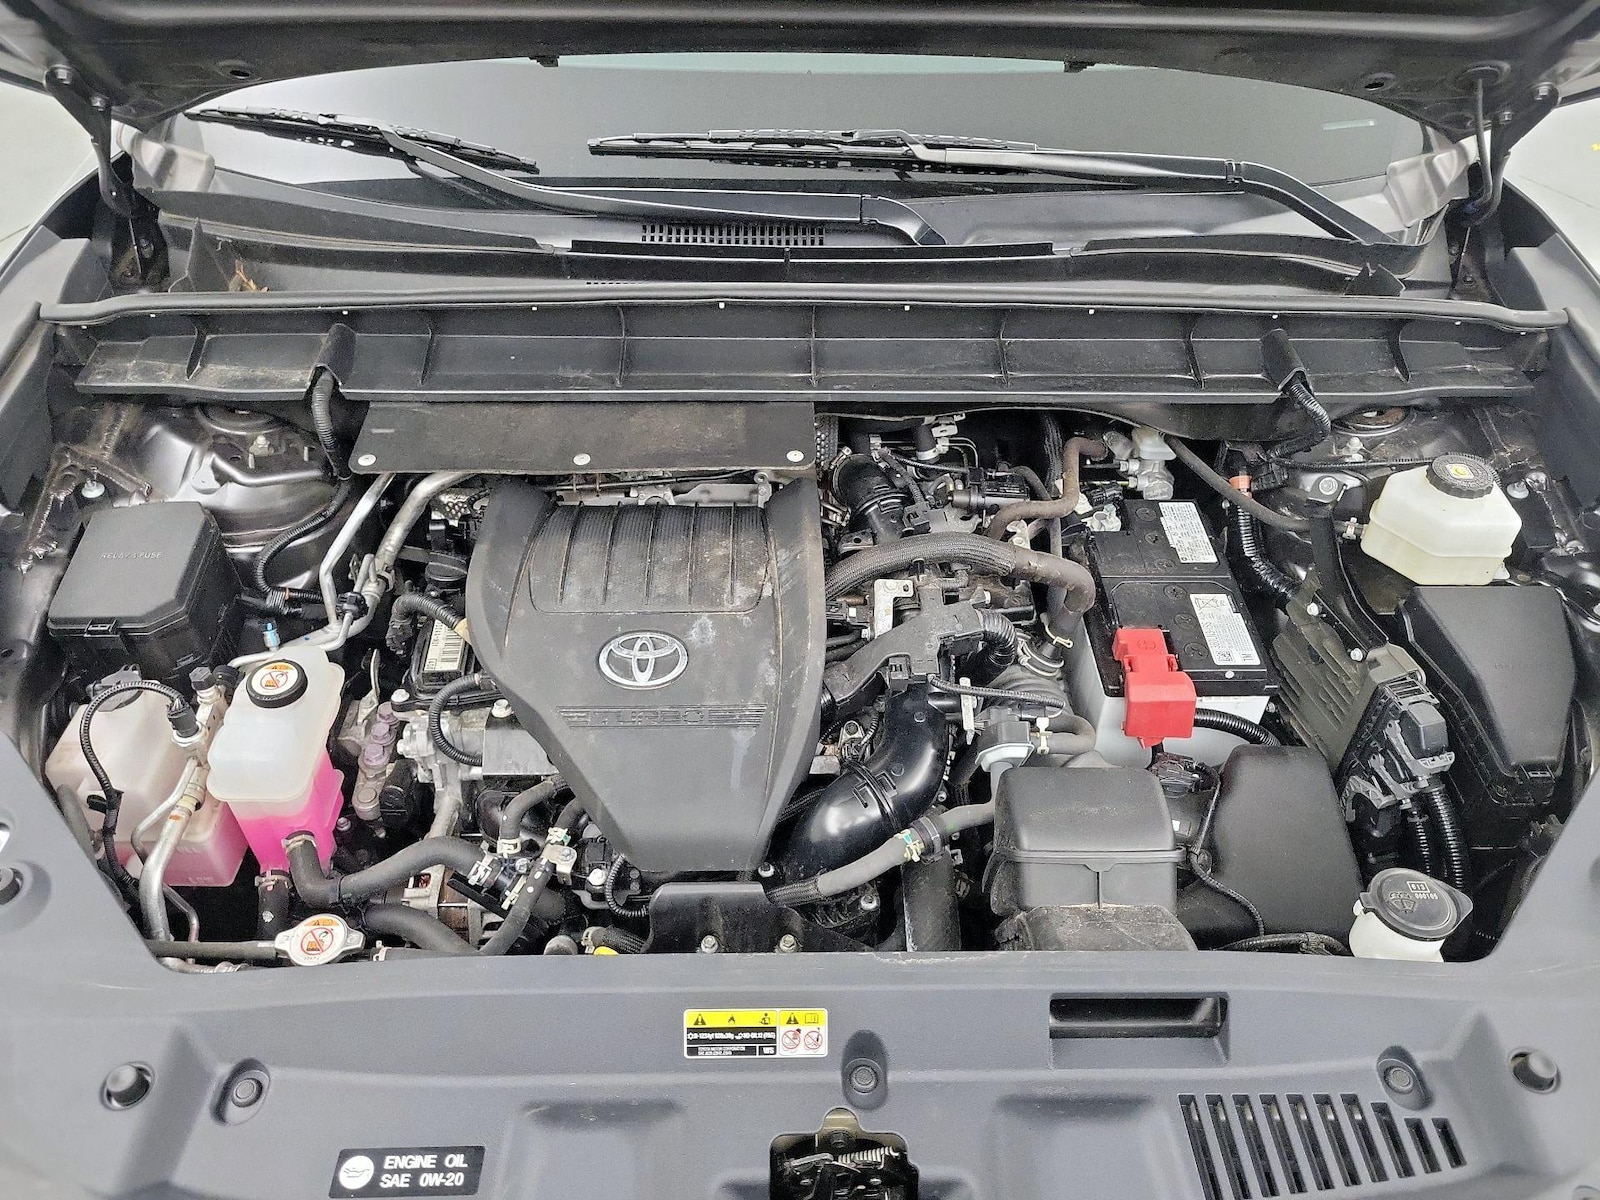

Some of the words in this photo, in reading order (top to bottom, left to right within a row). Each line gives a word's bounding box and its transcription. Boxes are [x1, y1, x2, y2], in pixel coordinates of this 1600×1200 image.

[593, 710, 704, 725] TURBO
[384, 1155, 437, 1169] ENGINE
[444, 1154, 468, 1168] OIL
[379, 1173, 411, 1188] SAE
[419, 1172, 465, 1187] 0W-20
